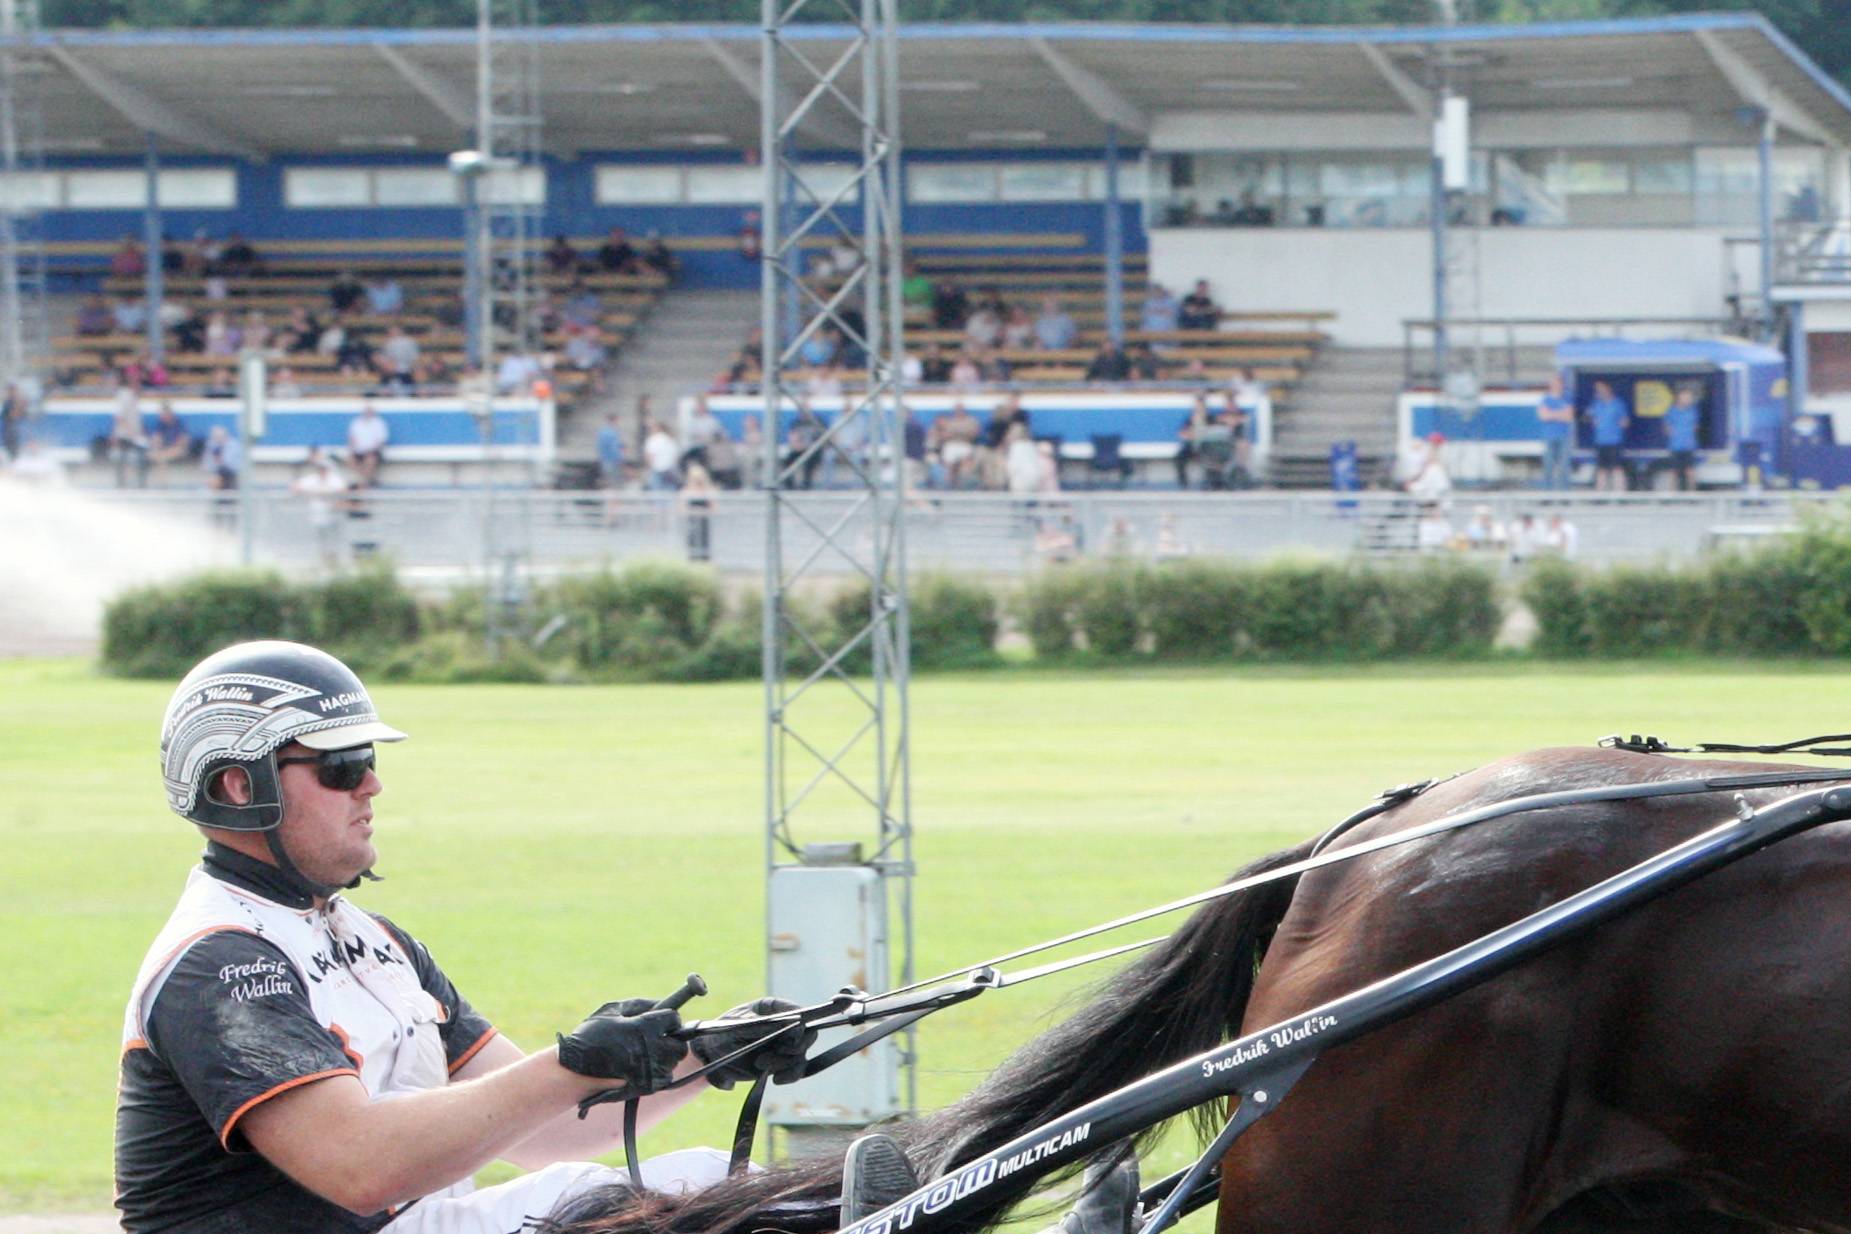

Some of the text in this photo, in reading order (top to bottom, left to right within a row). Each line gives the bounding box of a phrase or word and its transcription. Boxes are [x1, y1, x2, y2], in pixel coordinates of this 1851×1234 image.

[205, 685, 253, 702] Wallin
[219, 956, 287, 985] Fredrik
[231, 973, 293, 1003] Wallin
[1202, 1039, 1270, 1078] Fredrik
[998, 1121, 1091, 1179] MULTICAM
